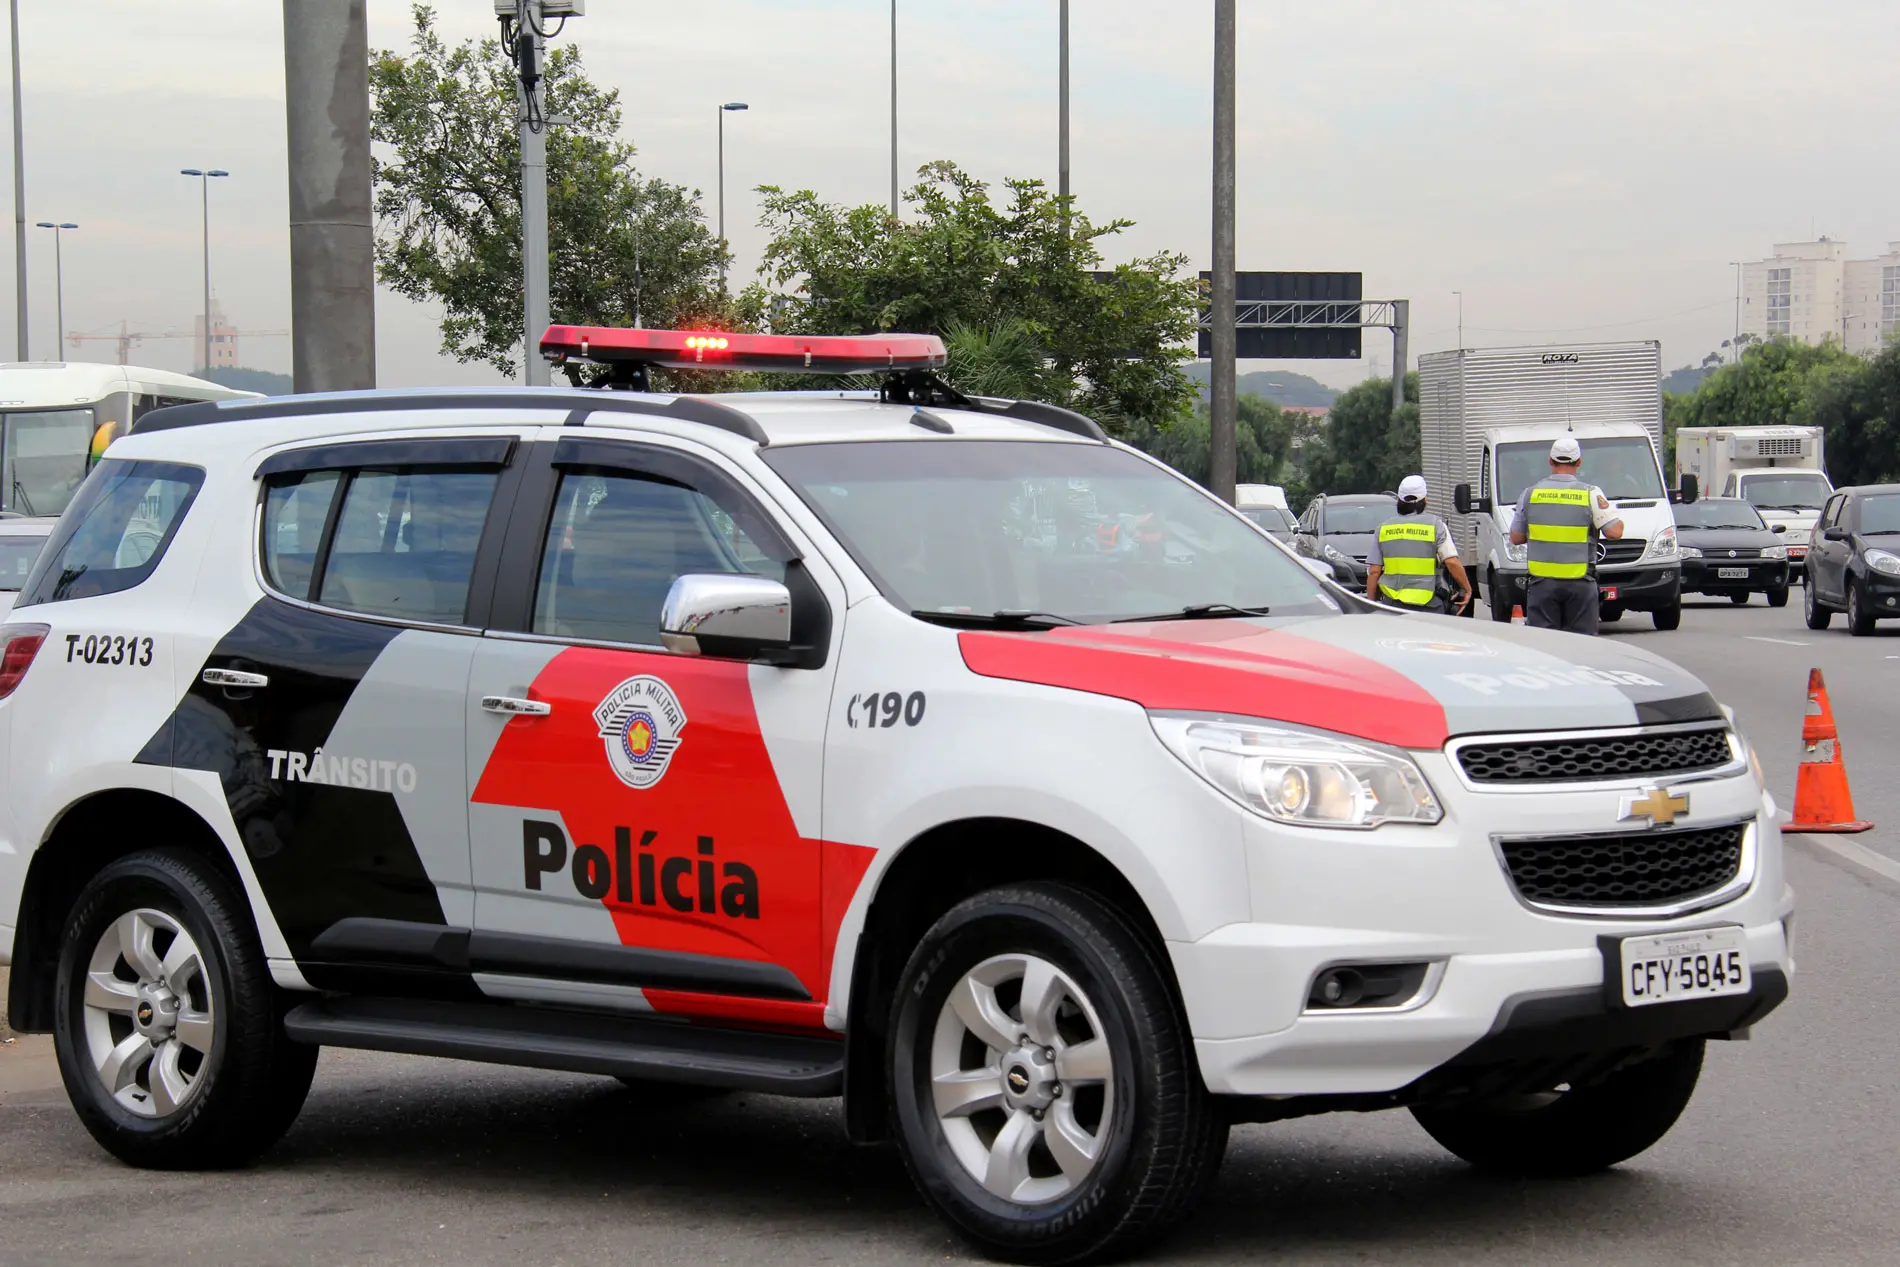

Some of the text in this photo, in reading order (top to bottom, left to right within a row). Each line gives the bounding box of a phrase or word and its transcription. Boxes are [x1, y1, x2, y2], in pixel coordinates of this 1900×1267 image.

[1560, 493, 1583, 501] MILITAR
[1406, 528, 1429, 536] MILITAR
[65, 634, 154, 667] T-02313
[601, 683, 679, 728] POLICIA MILITAR
[863, 690, 926, 728] 190
[267, 747, 418, 793] TRÂNSITO
[523, 818, 760, 920] Polícia
